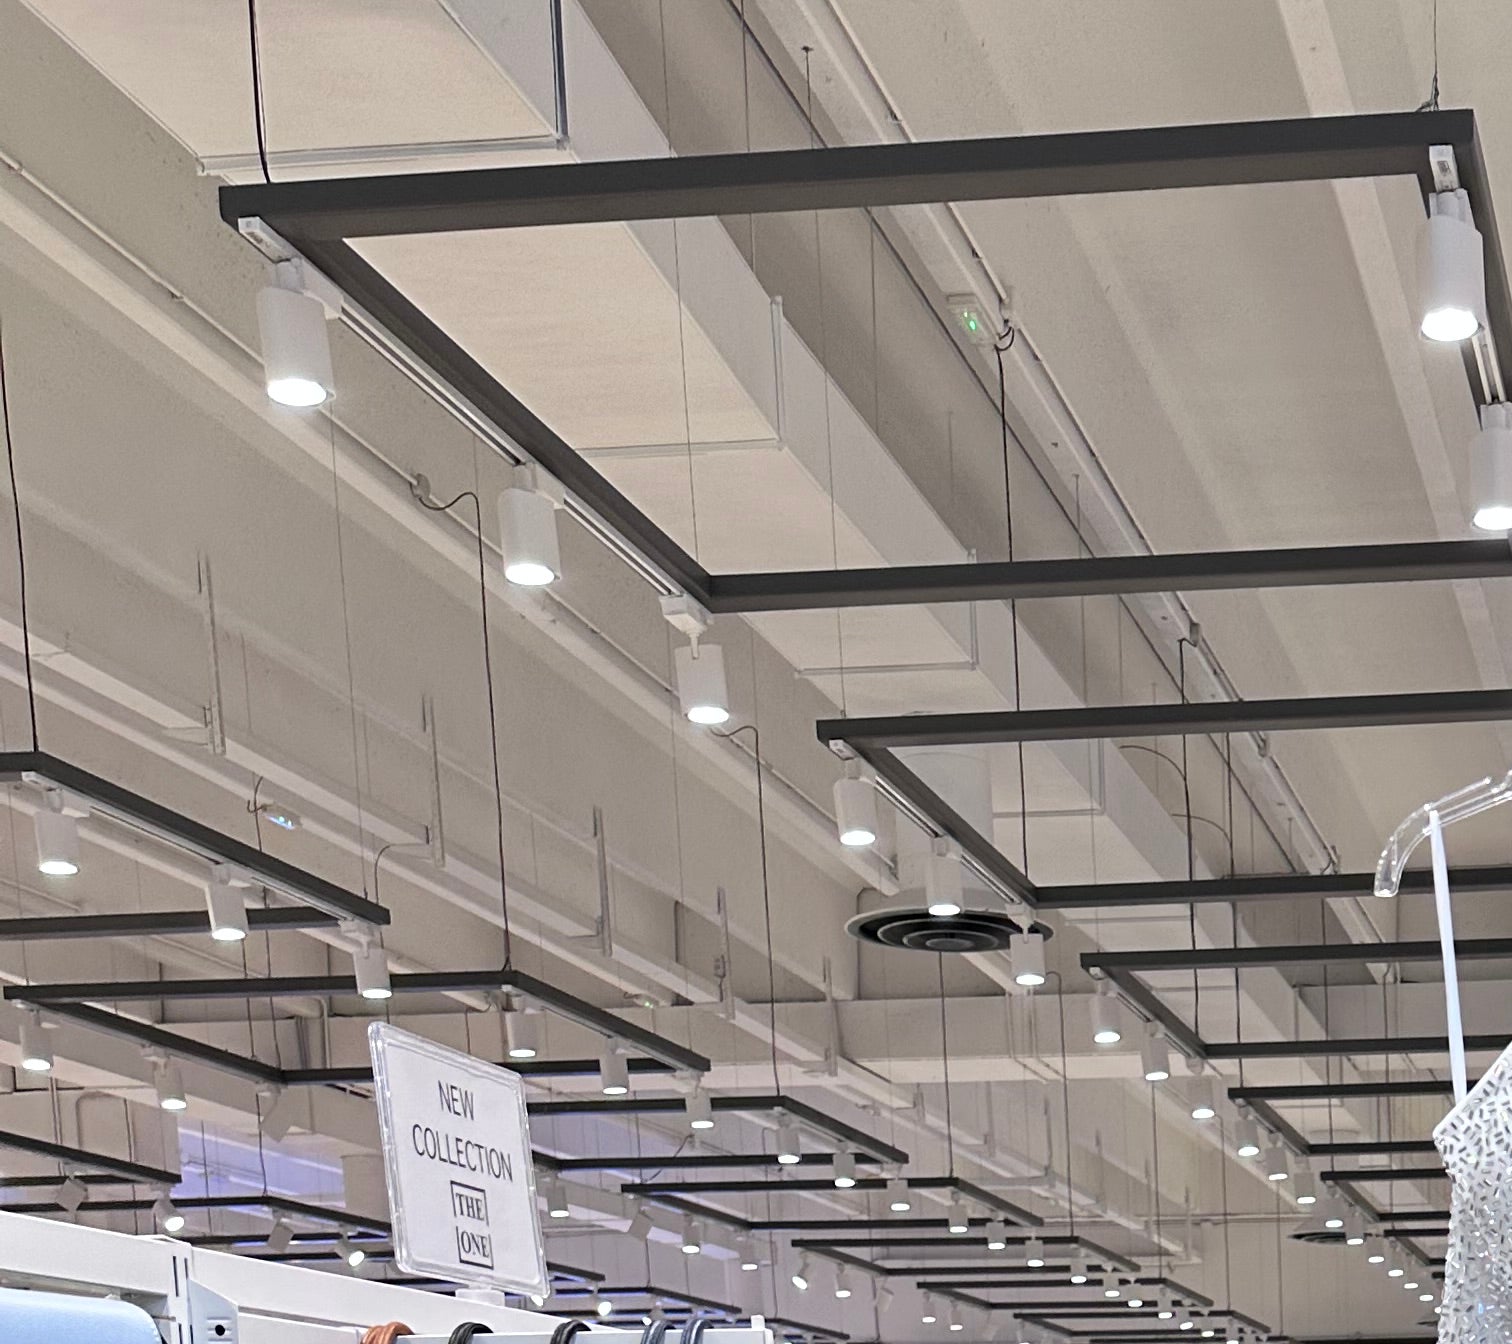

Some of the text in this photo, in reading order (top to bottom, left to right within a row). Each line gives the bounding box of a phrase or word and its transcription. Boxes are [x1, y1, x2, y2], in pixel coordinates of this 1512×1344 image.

[437, 1079, 475, 1121] NEW
[411, 1123, 514, 1183] COLLECTION
[455, 1192, 486, 1222] THE
[460, 1229, 490, 1259] ONE
